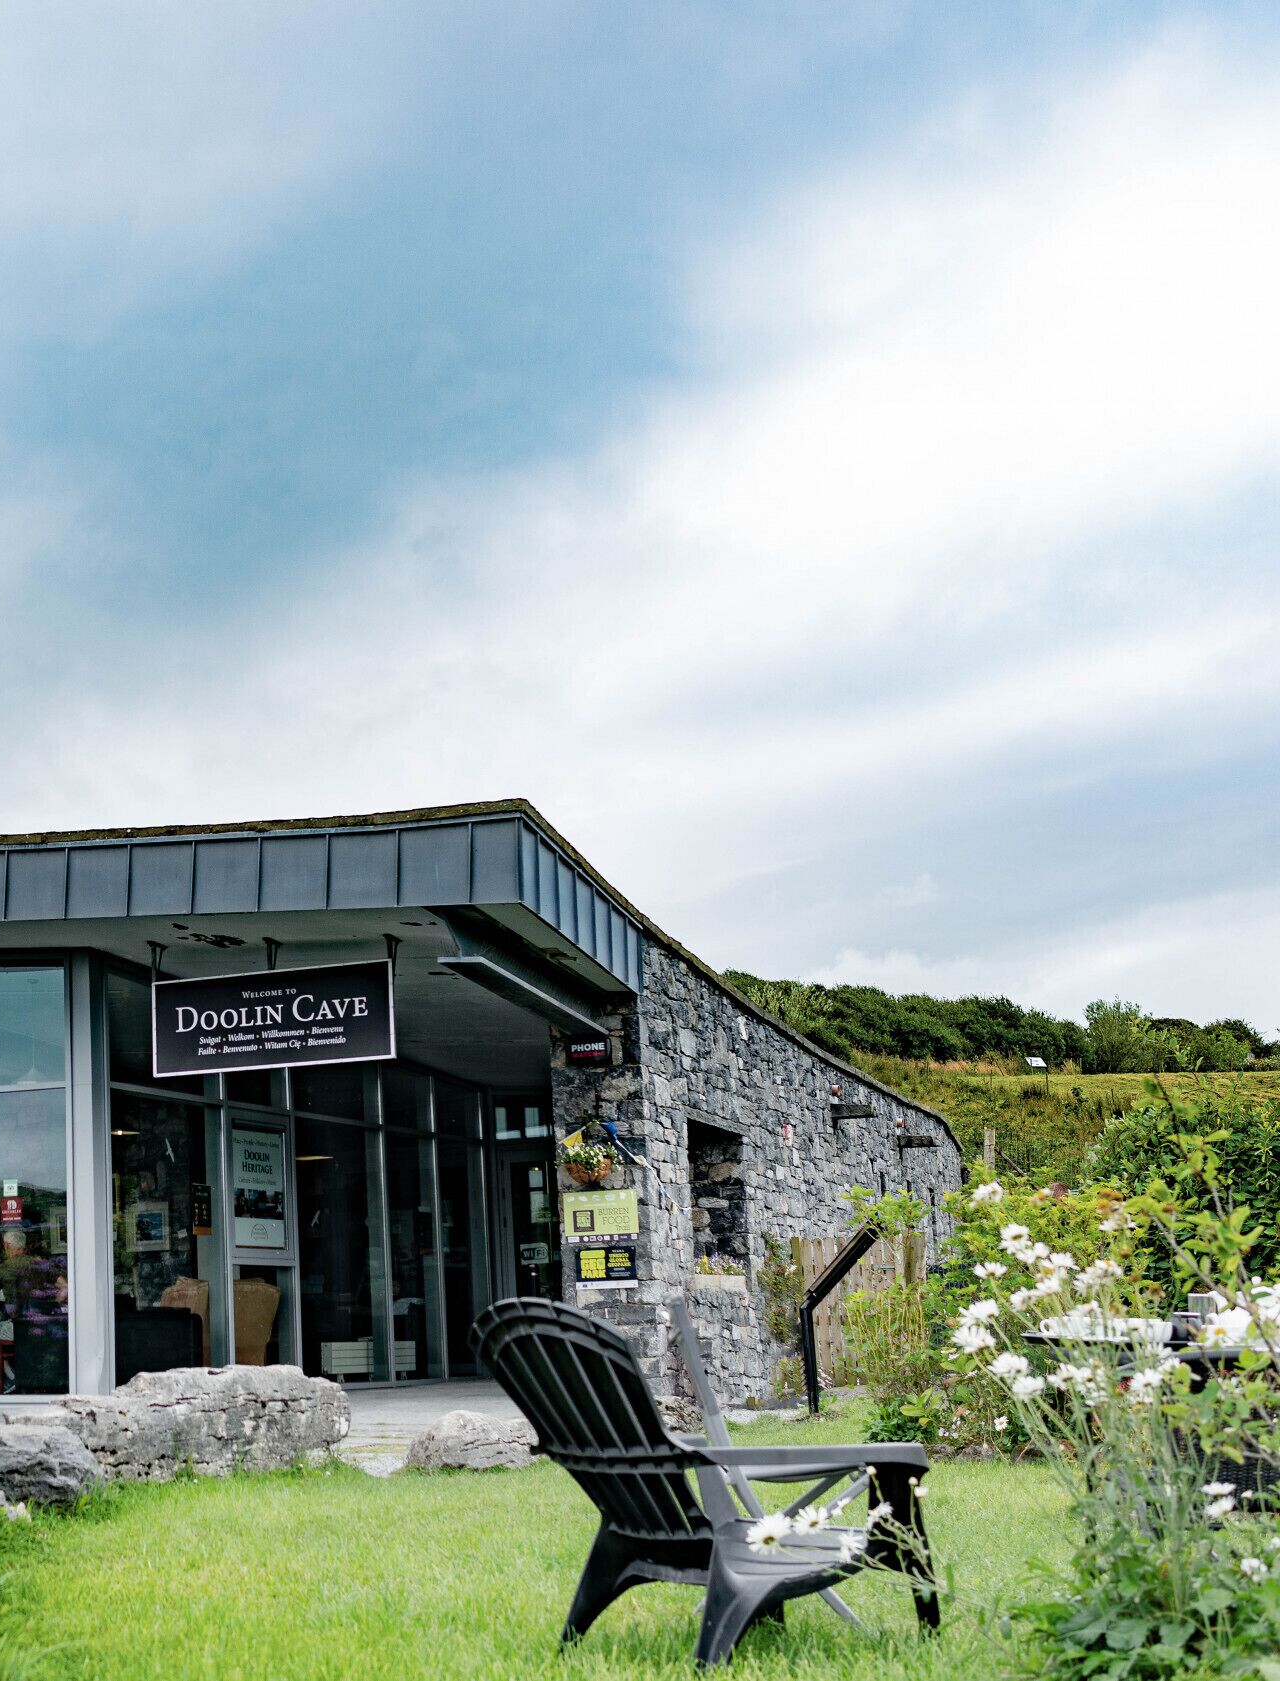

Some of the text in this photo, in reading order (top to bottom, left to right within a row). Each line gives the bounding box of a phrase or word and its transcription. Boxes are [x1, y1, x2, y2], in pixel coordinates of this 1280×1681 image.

[241, 989, 282, 999] WELCOME
[175, 994, 368, 1033] DOOLIN CAVE
[228, 1033, 255, 1042] Welkom
[261, 1029, 305, 1039] Willkommen
[311, 1026, 344, 1035] Bienvenu
[222, 1044, 258, 1054] Benvenuto
[264, 1042, 288, 1050] Witam
[307, 1035, 346, 1046] Bienvenido
[571, 1042, 606, 1052] PHONE
[244, 1149, 270, 1162] DOOLIN
[242, 1161, 273, 1174] HERITAGE
[597, 1207, 629, 1216] BURREN
[602, 1216, 631, 1225] FOOD
[581, 1269, 607, 1279] PARK
